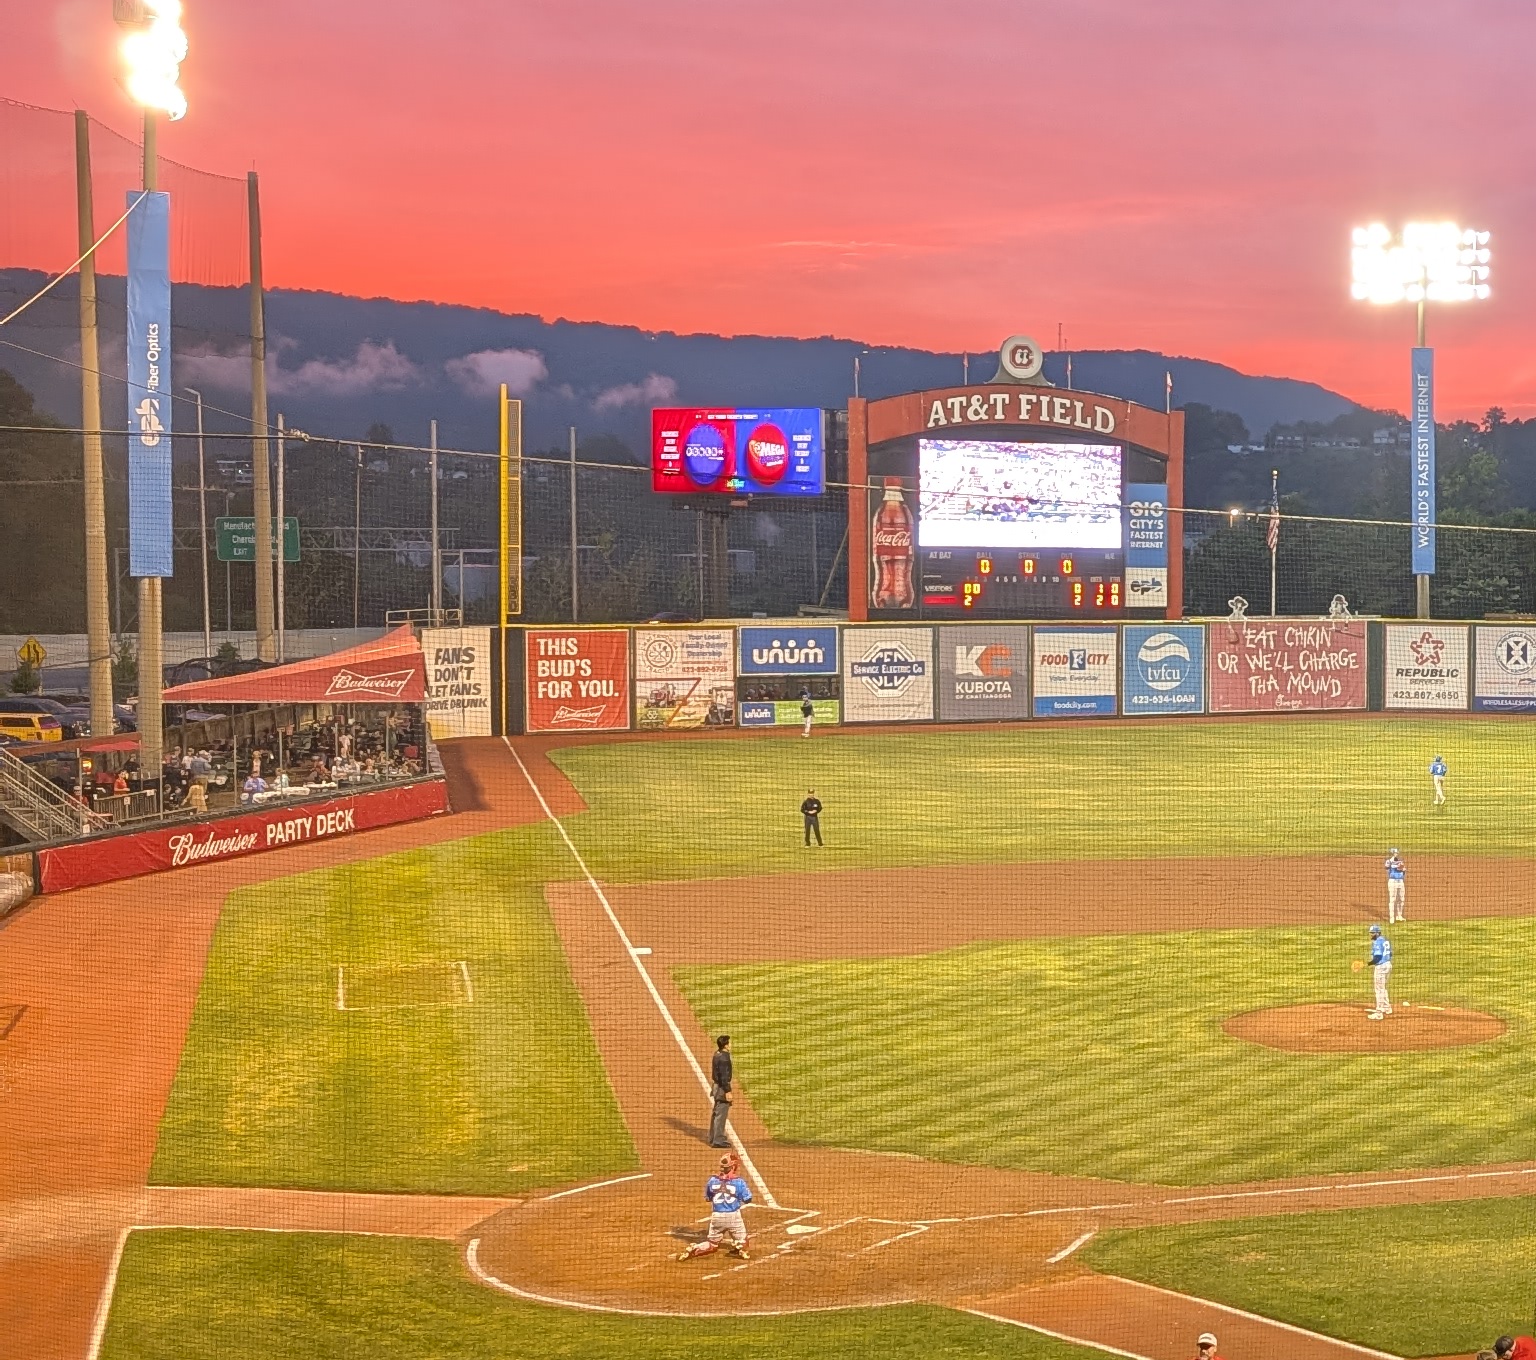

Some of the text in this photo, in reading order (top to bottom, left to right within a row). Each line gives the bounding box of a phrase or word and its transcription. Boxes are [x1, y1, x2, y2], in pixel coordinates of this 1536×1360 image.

[147, 323, 161, 362] Optics
[147, 364, 159, 394] Fiber
[927, 393, 1116, 435] AT&T FIELD
[1418, 373, 1429, 549] WORLD'S FASTEST INTERNET
[1129, 519, 1164, 530] CITY'S
[1129, 531, 1164, 540] FASTEST
[1129, 541, 1164, 549] INTERNET
[976, 551, 993, 560] BALL
[1018, 551, 1041, 560] STRIKE
[1060, 551, 1073, 560] OUT
[980, 559, 991, 574] 0
[1024, 559, 1034, 574] 0
[1062, 559, 1073, 574] 0
[924, 584, 953, 592] VISITORS
[964, 596, 972, 607] 2
[1074, 596, 1081, 606] 2
[1096, 596, 1104, 606] 2
[1244, 626, 1332, 650] EAT CHIKIN
[537, 637, 578, 656] THIS
[434, 646, 476, 666] FANS
[1040, 653, 1110, 666] FOOD CITY
[1217, 648, 1360, 674] OR WE'LL CHARGE
[434, 667, 475, 683] DON'T
[537, 658, 592, 678] BUD'S
[1147, 663, 1181, 681] tvfcu
[1396, 668, 1460, 678] REPUBLIC
[332, 673, 407, 690] Budweiser
[537, 679, 620, 699] FOR YOU.
[955, 681, 1012, 694] KUBOTA
[1248, 672, 1342, 698] THA MOUND
[431, 683, 482, 699] LET FANS
[426, 697, 488, 711] DRIVE DRUNK
[1054, 700, 1097, 710] foodcity.com
[556, 707, 601, 720] Budweiser
[168, 807, 355, 867] Budweiser PARTY DECK
